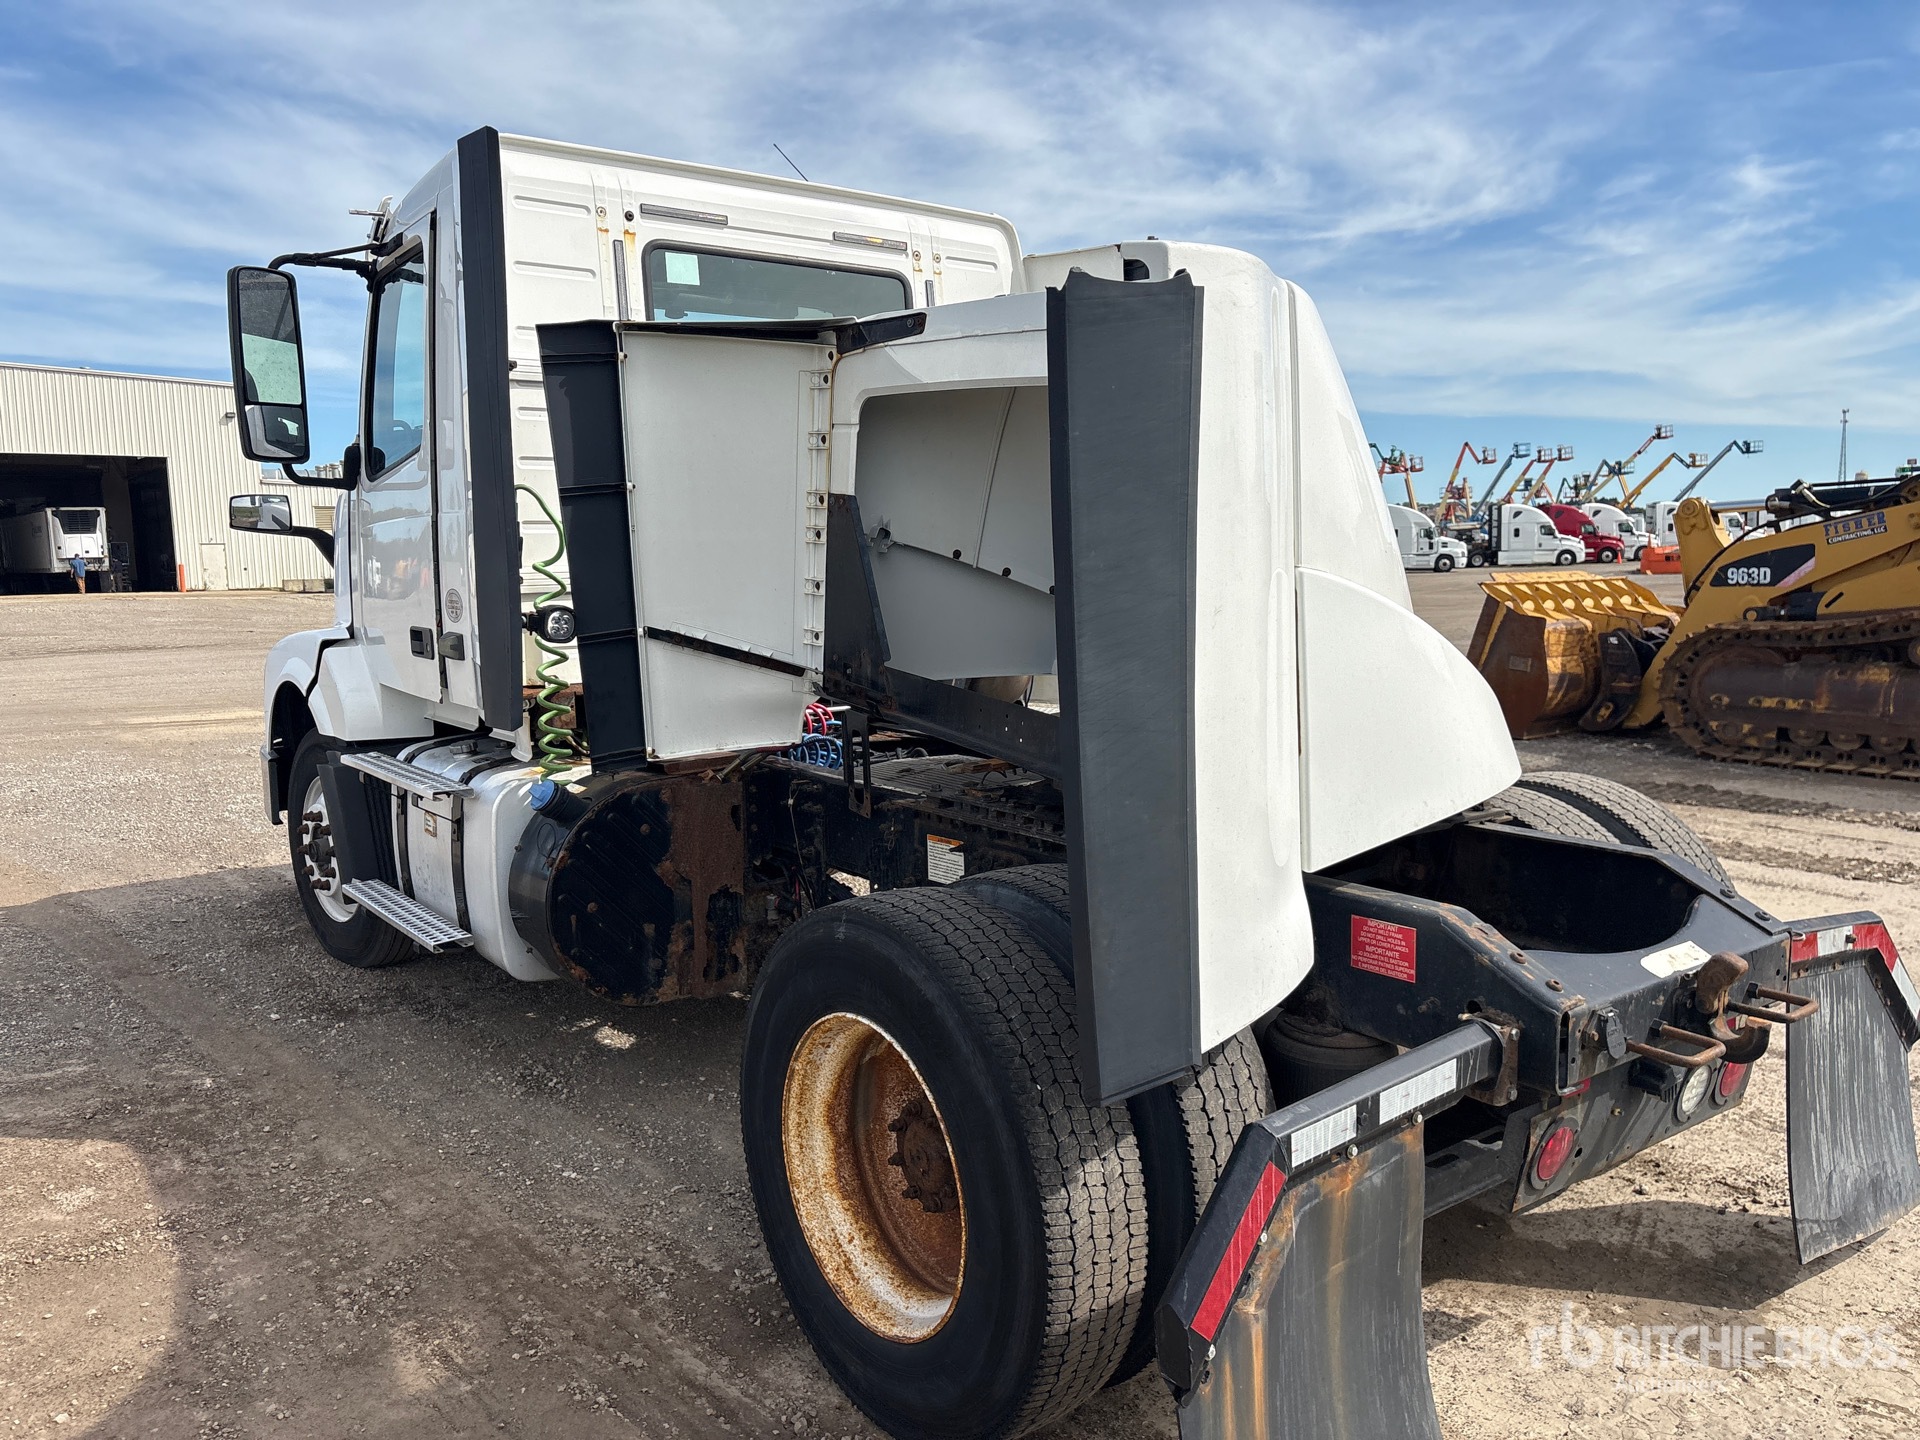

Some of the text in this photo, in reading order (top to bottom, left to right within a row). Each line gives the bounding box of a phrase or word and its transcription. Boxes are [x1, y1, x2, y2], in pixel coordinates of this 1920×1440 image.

[1823, 511, 1886, 536] FISHER
[1728, 567, 1771, 584] 963D
[1368, 920, 1398, 932] IMPORTANT
[1390, 931, 1403, 939] FRAME
[1366, 945, 1400, 959] IMPORTANTE
[1391, 944, 1408, 953] FLANGES
